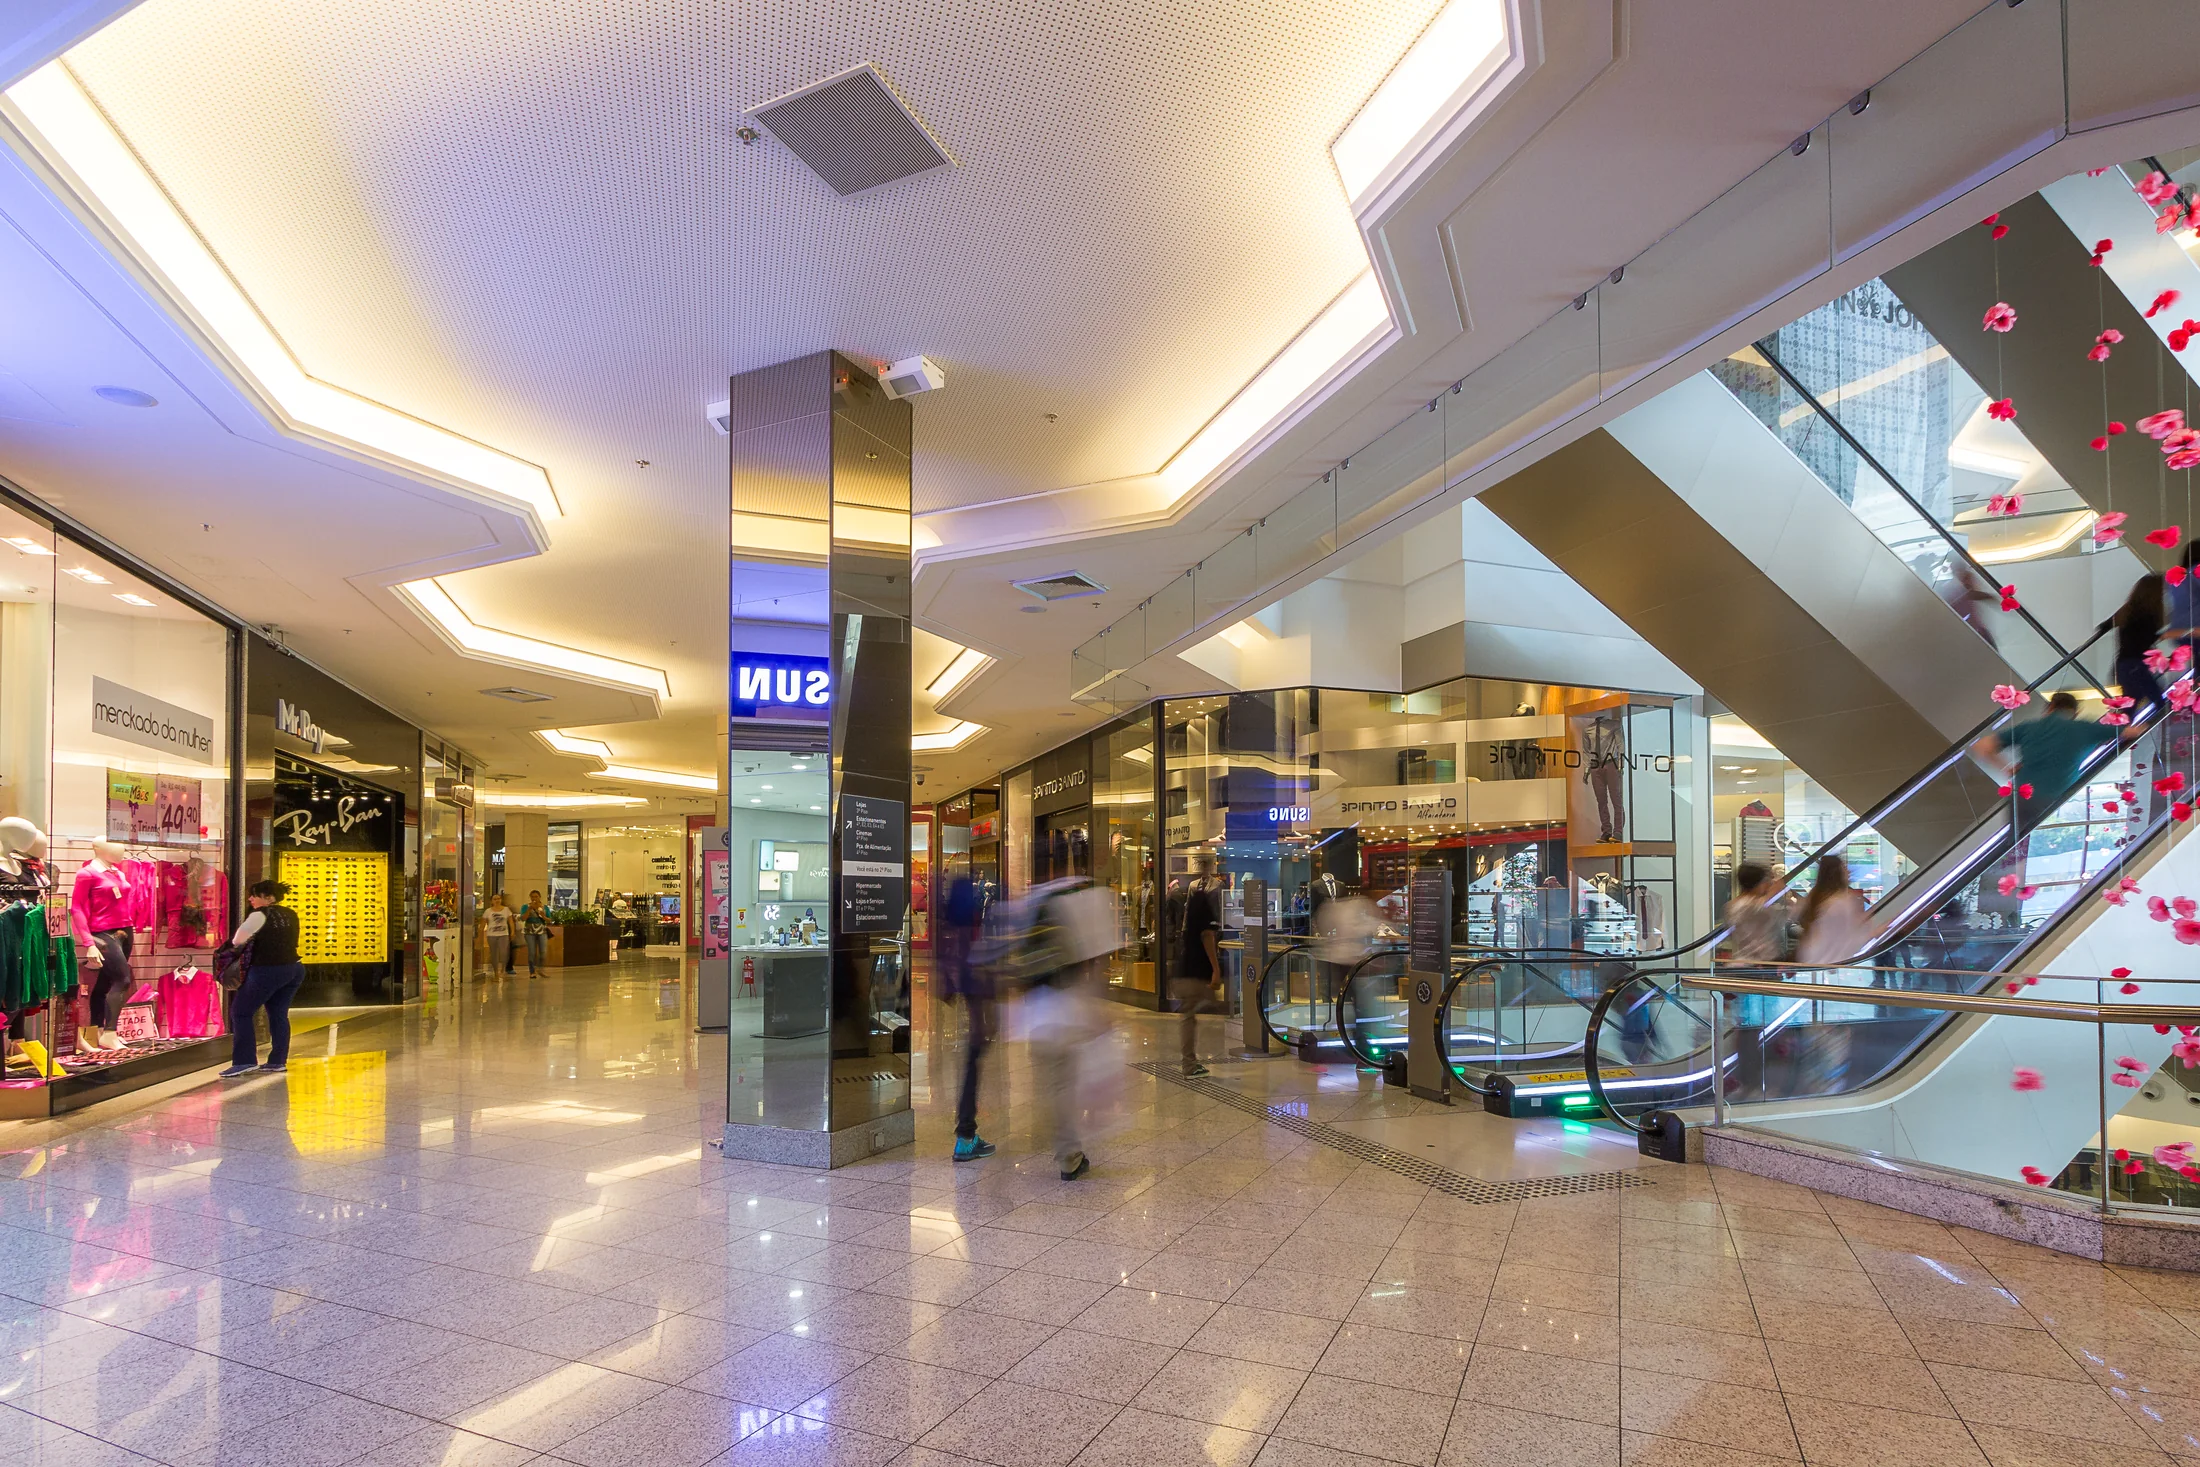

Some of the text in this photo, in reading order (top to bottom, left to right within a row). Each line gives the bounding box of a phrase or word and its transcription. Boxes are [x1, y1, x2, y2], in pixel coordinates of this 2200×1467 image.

[95, 703, 211, 753] merckado da mulher
[117, 1016, 147, 1026] ETADE
